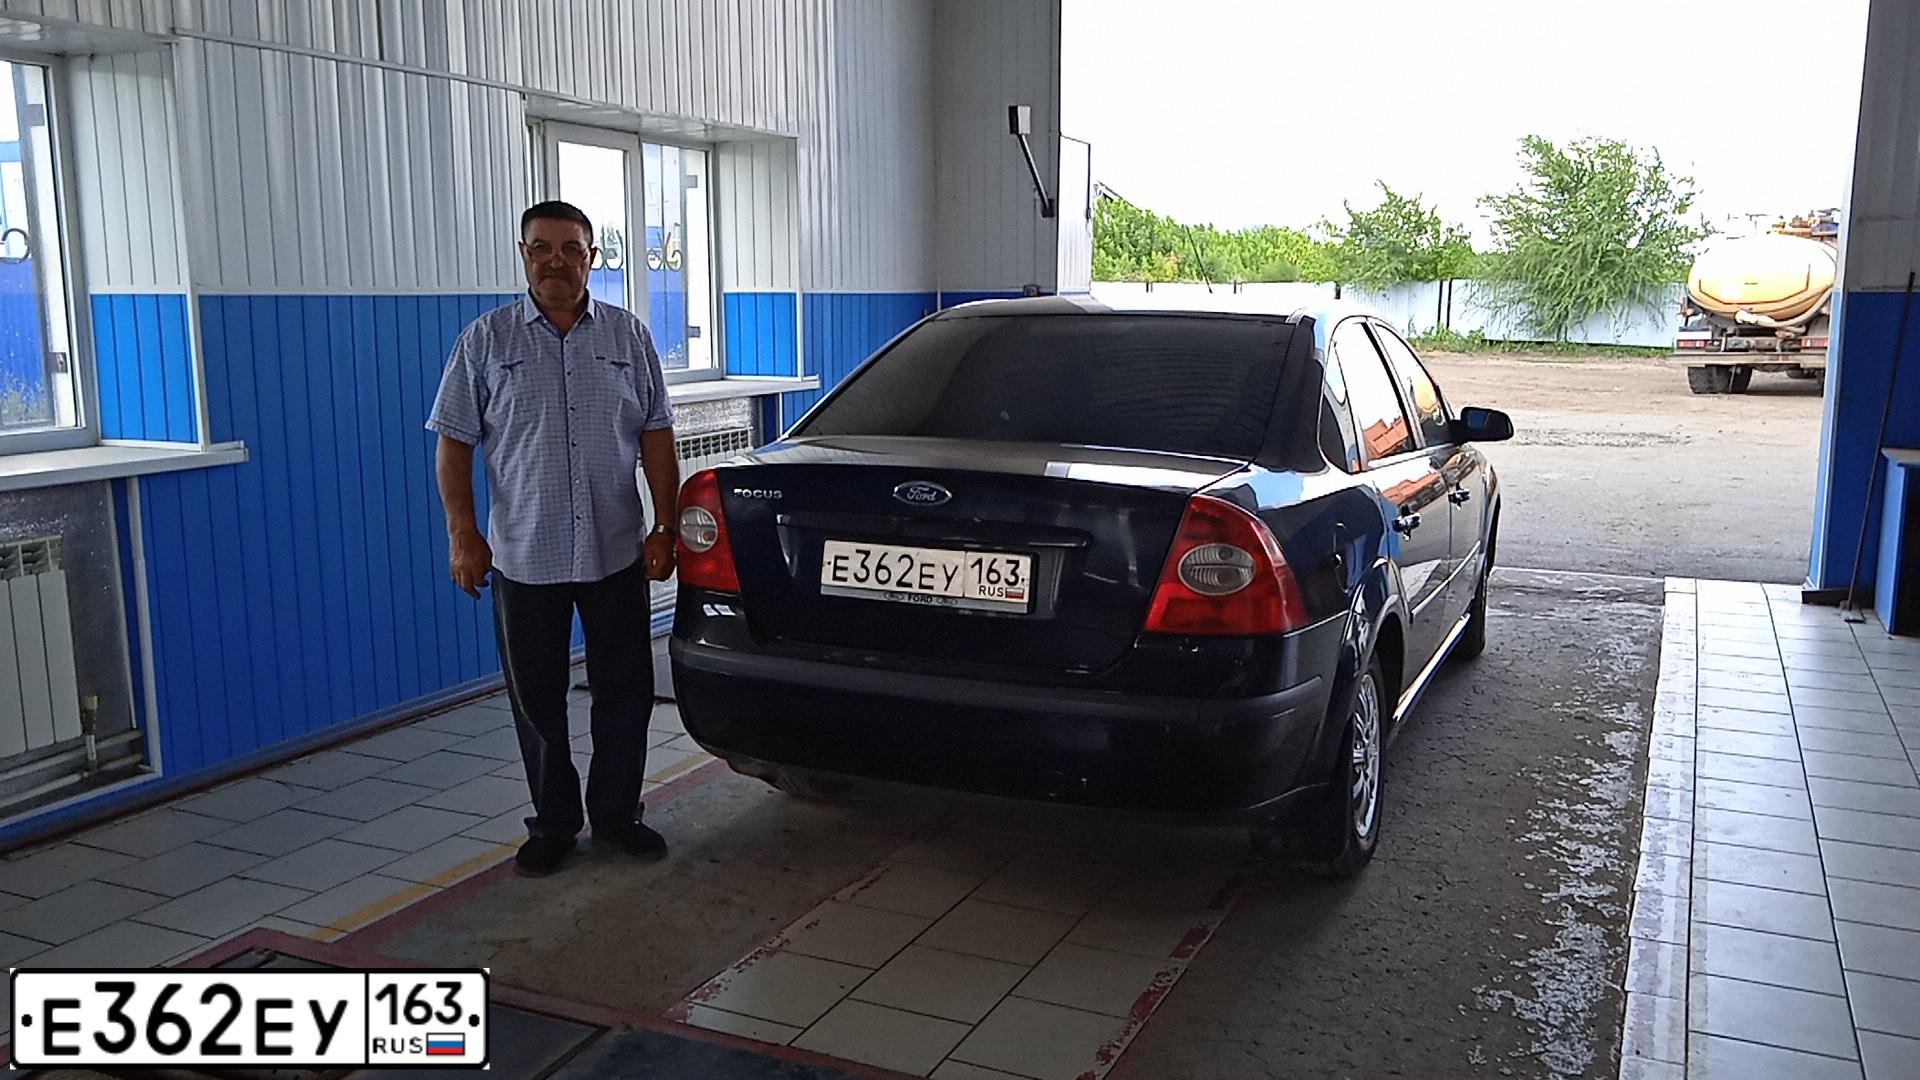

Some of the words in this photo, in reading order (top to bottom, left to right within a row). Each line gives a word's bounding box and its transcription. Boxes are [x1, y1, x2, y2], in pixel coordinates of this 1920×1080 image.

[733, 488, 783, 499] FOCUS
[906, 487, 937, 502] Ford
[970, 557, 1021, 587] 163
[978, 586, 1004, 598] RUS
